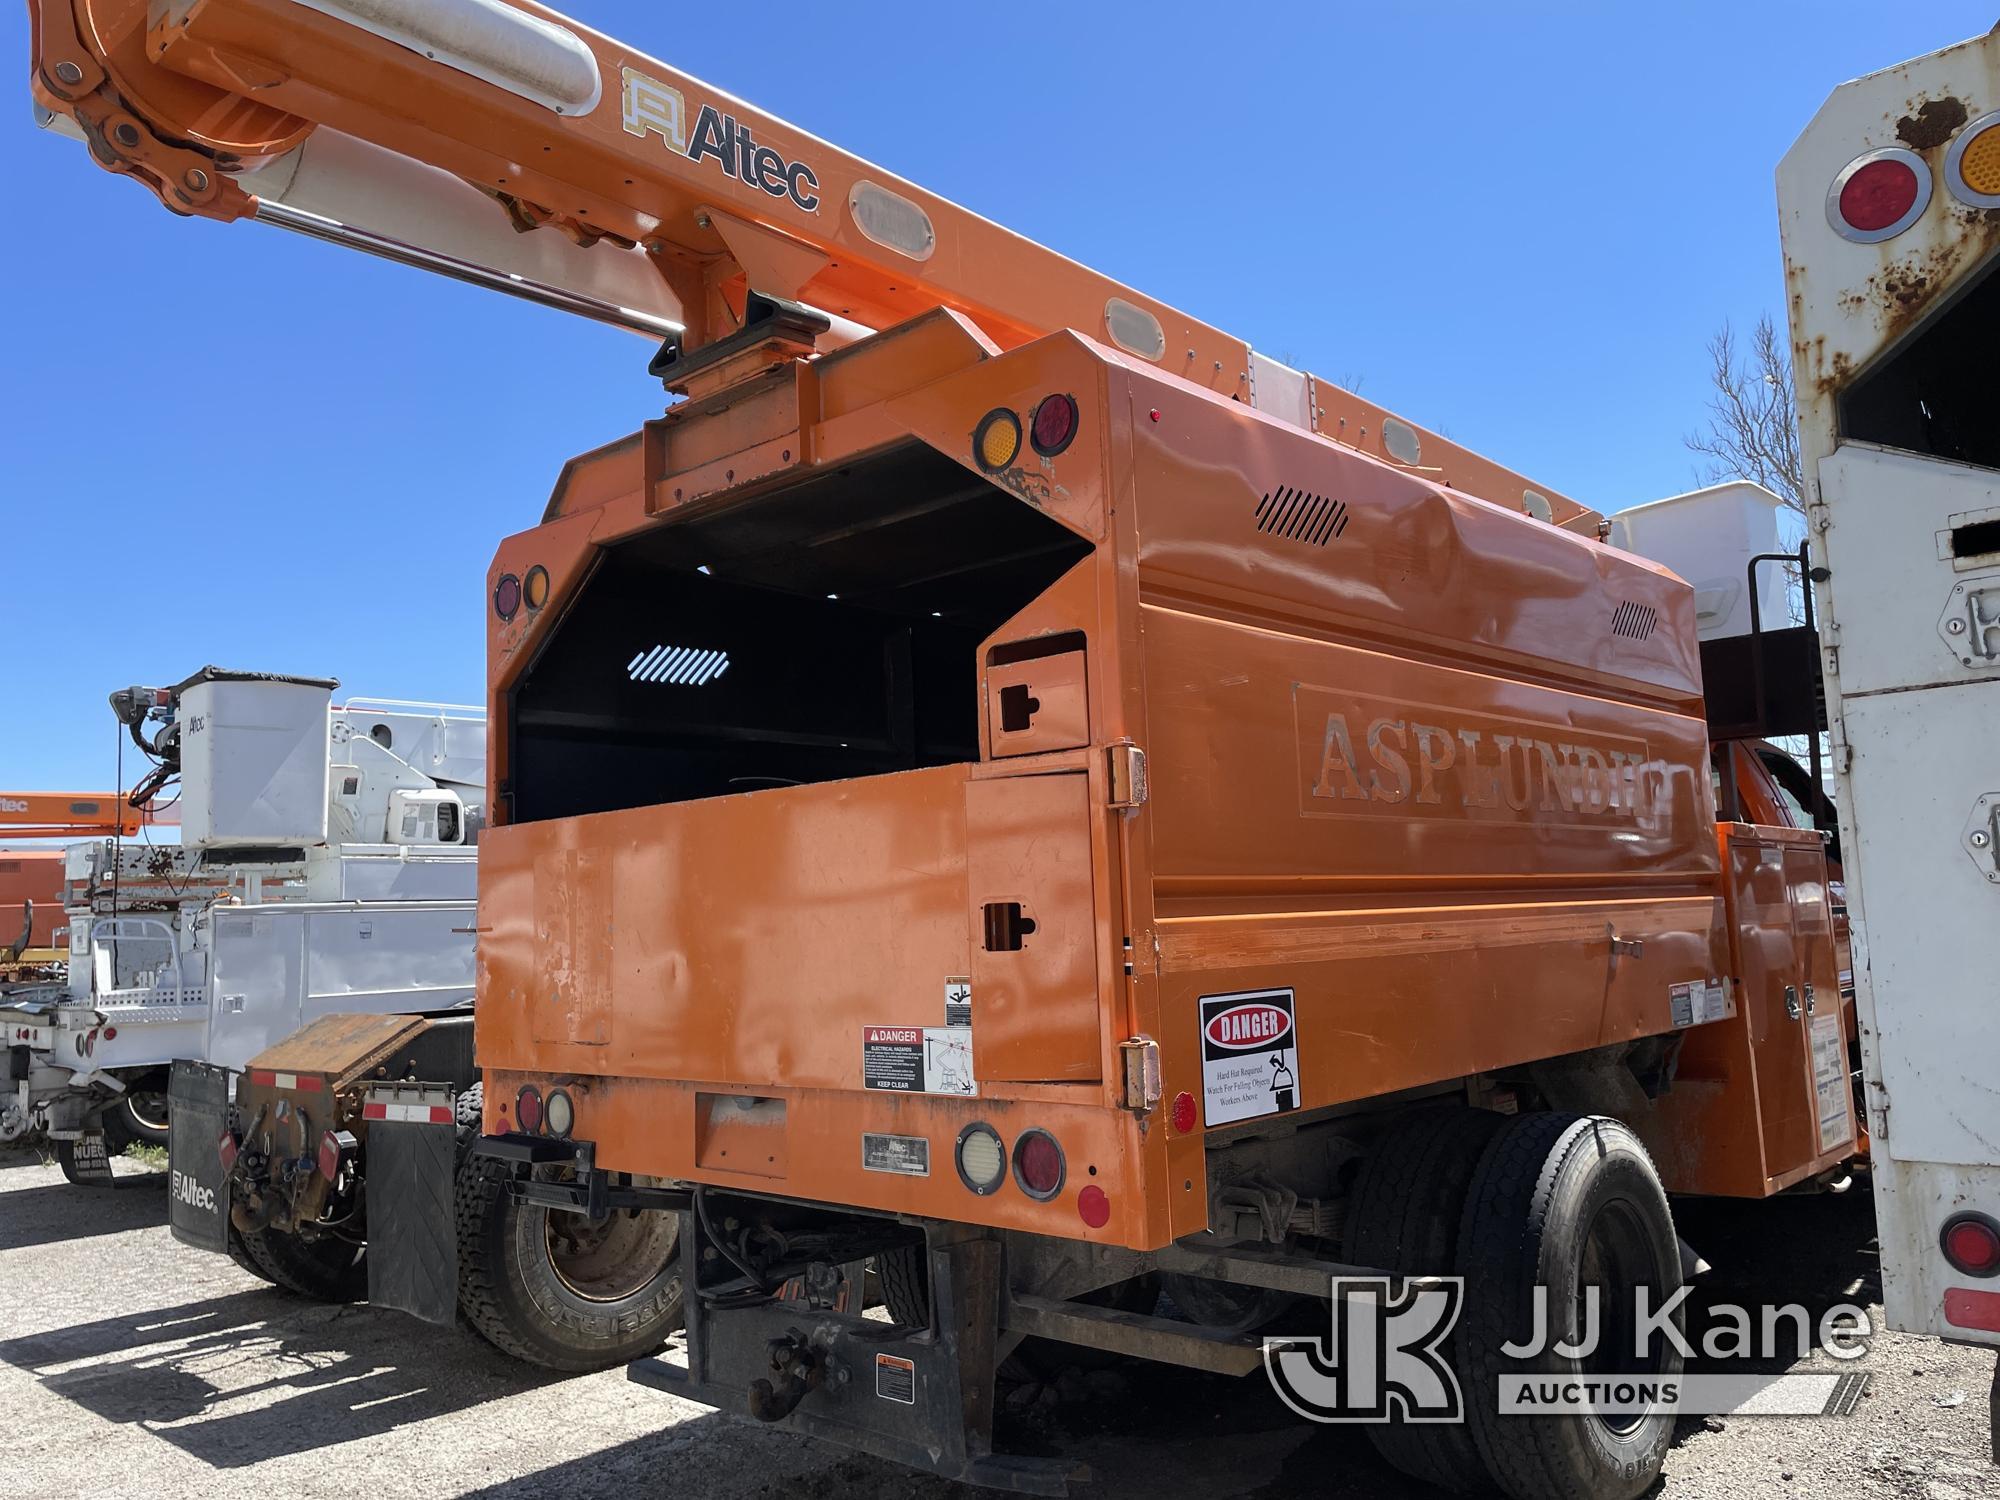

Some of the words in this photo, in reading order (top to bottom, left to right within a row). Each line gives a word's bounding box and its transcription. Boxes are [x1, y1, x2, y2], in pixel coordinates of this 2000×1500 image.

[688, 104, 819, 212] Altec
[1312, 712, 1647, 816] ASPLUNDH
[880, 1030, 917, 1042] DANGER
[1220, 1011, 1279, 1042] DANGER
[1217, 1071, 1229, 1081] Hard
[1230, 1068, 1240, 1078] Hat
[1240, 1066, 1263, 1077] Required
[1207, 1085, 1223, 1095] Watch
[1224, 1083, 1234, 1093] For
[1234, 1080, 1252, 1092] Falling
[1220, 1097, 1241, 1106] Workers
[1242, 1093, 1258, 1102] Above
[180, 1175, 214, 1210] Altec
